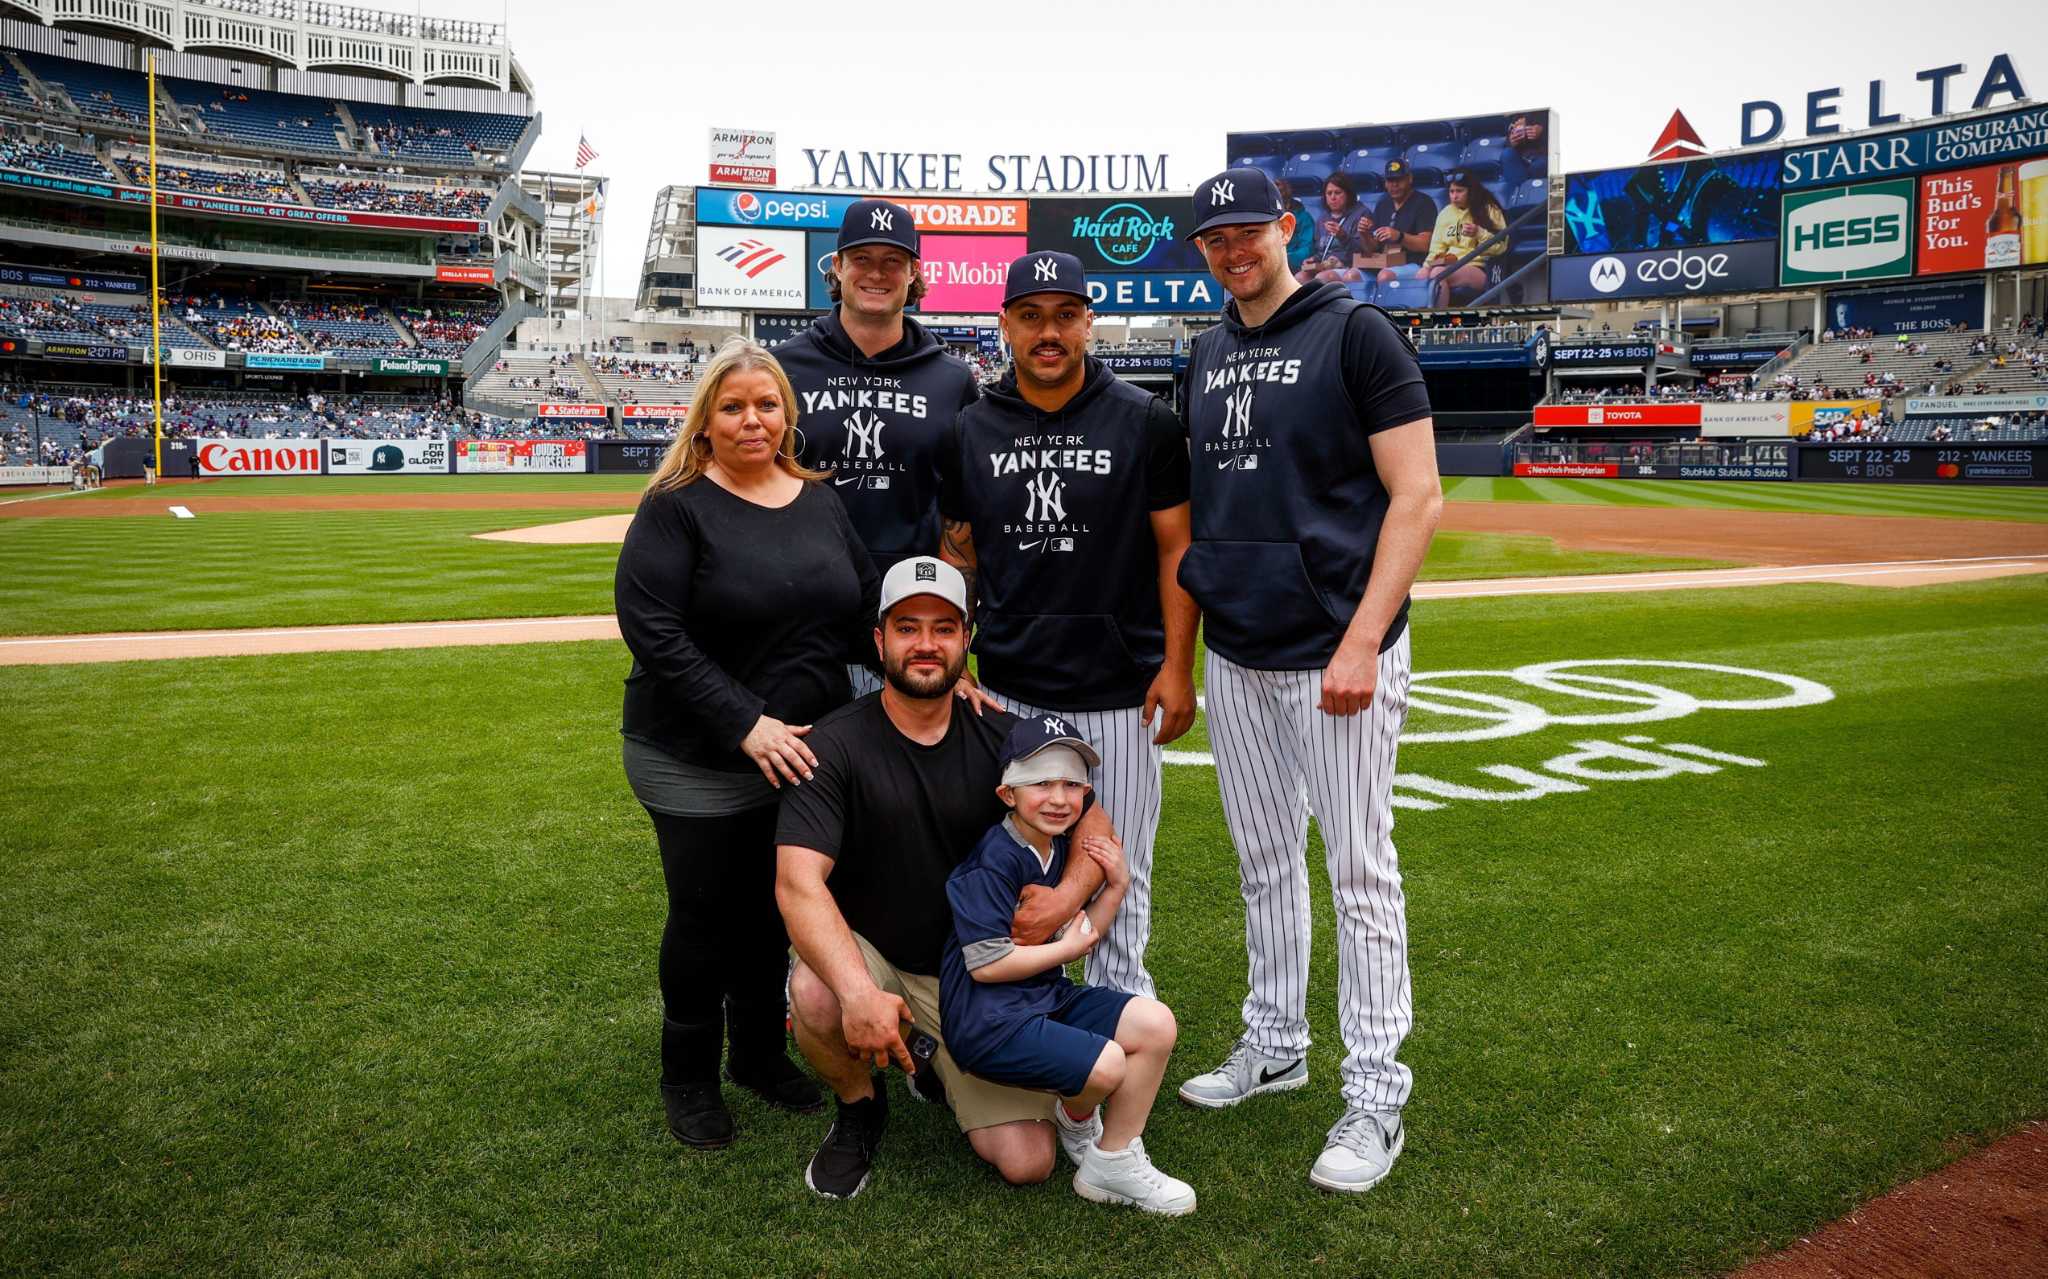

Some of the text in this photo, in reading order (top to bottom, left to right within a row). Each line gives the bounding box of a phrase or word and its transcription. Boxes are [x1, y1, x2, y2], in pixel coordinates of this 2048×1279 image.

[1741, 53, 2030, 146] DELTA
[713, 132, 773, 145] ARMITRON
[1783, 137, 1919, 184] STARR
[716, 167, 770, 178] ARMITRON
[803, 149, 1169, 192] YANKEE STADIUM
[1211, 179, 1235, 207] NY
[1926, 177, 1973, 198] This
[182, 197, 199, 208] HEY
[201, 200, 240, 213] YANKEES
[269, 208, 286, 217] GET
[287, 209, 315, 220] GREAT
[316, 213, 350, 223] OFFERS.
[1926, 193, 1982, 215] Bud's
[870, 207, 894, 231] NY
[1926, 216, 1960, 233] For
[1072, 215, 1174, 241] Hard Rock
[1794, 214, 1900, 252] HESS
[1926, 233, 1969, 250] You.
[0, 269, 24, 281] BOS
[1033, 257, 1058, 282] NY
[1636, 250, 1729, 290] edge
[104, 280, 137, 290] YANKEES
[1090, 280, 1212, 304] DELTA
[699, 287, 802, 298] BANK OF AMERICA
[1893, 319, 1951, 330] THE BOSS
[47, 345, 88, 356] ARMITRON
[112, 348, 125, 359] PM
[183, 350, 217, 361] ORIS
[1225, 351, 1247, 364] NEW
[1554, 350, 1581, 360] SEPT
[1581, 348, 1612, 359] 22-25
[1625, 347, 1649, 357] BOS
[380, 360, 441, 374] Poland Spring
[1114, 358, 1141, 367] 22-25
[1153, 358, 1173, 367] BOS
[827, 376, 902, 389] NEW YORK
[1203, 359, 1302, 394] YANKEES
[801, 390, 928, 419] YANKEES
[1606, 411, 1642, 420] TOYOTA
[841, 409, 886, 460] NY
[1014, 435, 1042, 448] NEW
[532, 443, 565, 456] LOUDEST
[622, 447, 650, 457] SEPT
[1828, 450, 1862, 462] SEPT
[1865, 450, 1883, 462] 22
[1892, 450, 1911, 463] 25
[1938, 450, 1960, 461] 212
[1972, 450, 2033, 461] YANKEES
[199, 443, 319, 472] Canon
[408, 457, 444, 465] GLORY
[989, 449, 1112, 478] YANKEES
[819, 460, 907, 472] BASEBALL
[1680, 467, 1788, 477] StubHub StubHub StubHub
[1866, 464, 1895, 477] BOS
[1025, 470, 1068, 522] NY
[1004, 523, 1090, 533] BASEBALL
[1043, 717, 1067, 736] NY
